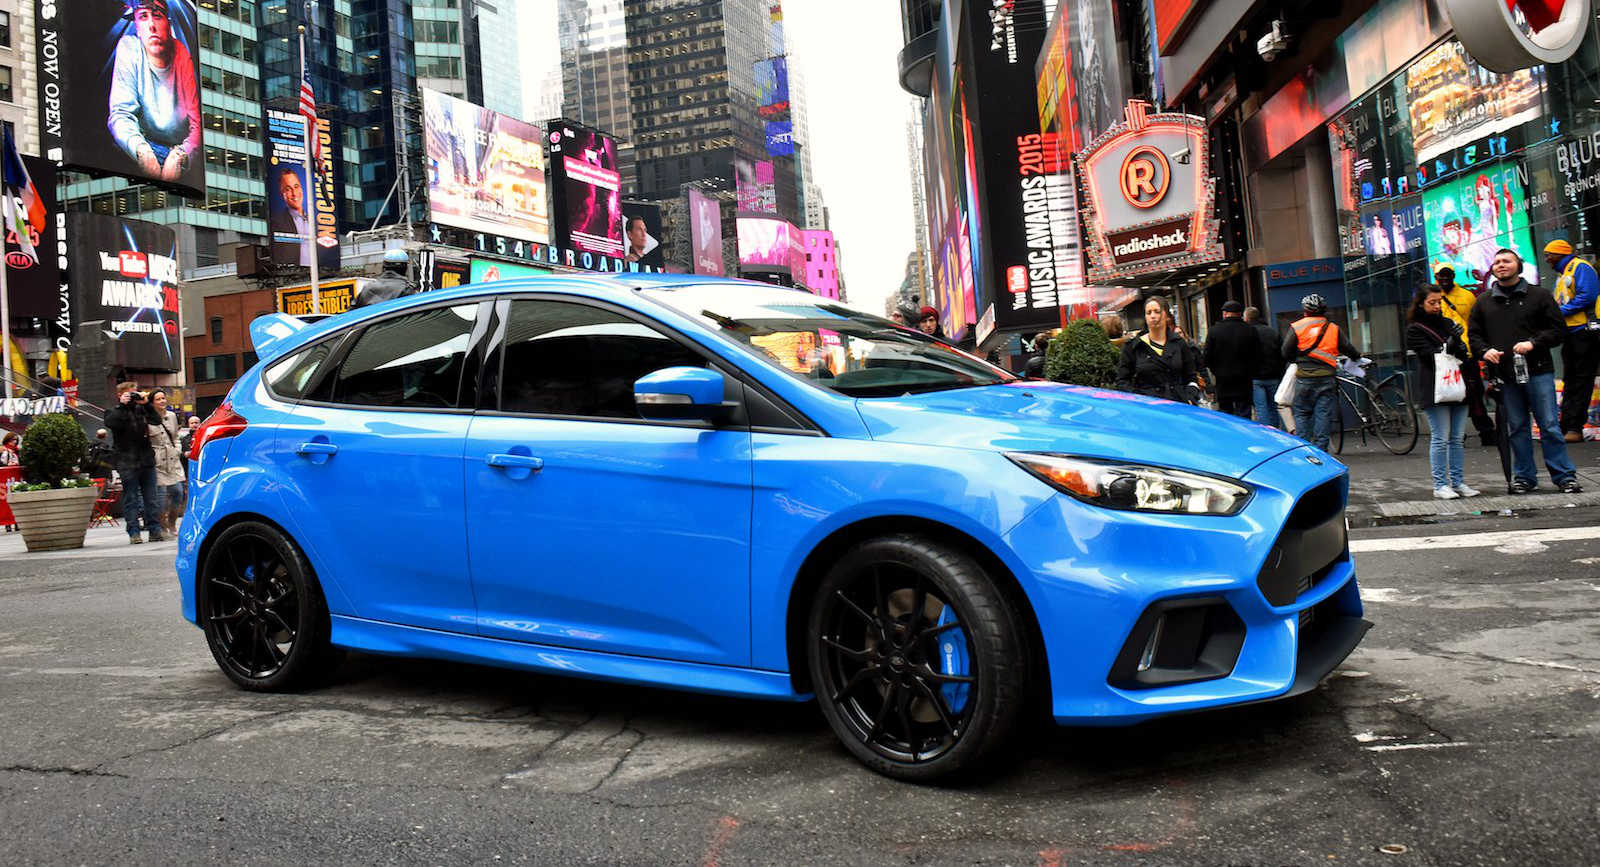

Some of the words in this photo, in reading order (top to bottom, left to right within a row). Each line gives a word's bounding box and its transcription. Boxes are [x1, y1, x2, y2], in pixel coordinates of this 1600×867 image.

[42, 28, 59, 79] NOW
[45, 83, 62, 137] OPEN
[551, 144, 561, 152] LG
[1017, 133, 1044, 176] 2015
[1021, 175, 1052, 249] AWARDS
[1531, 192, 1549, 208] BAR
[1114, 229, 1186, 257] radioshack
[8, 255, 29, 266] KIA
[1270, 265, 1307, 281] BLUE
[1311, 263, 1336, 274] FIN
[1028, 250, 1057, 309] MUSIC
[101, 280, 164, 310] AWARDS
[111, 321, 152, 333] PRESENTED
